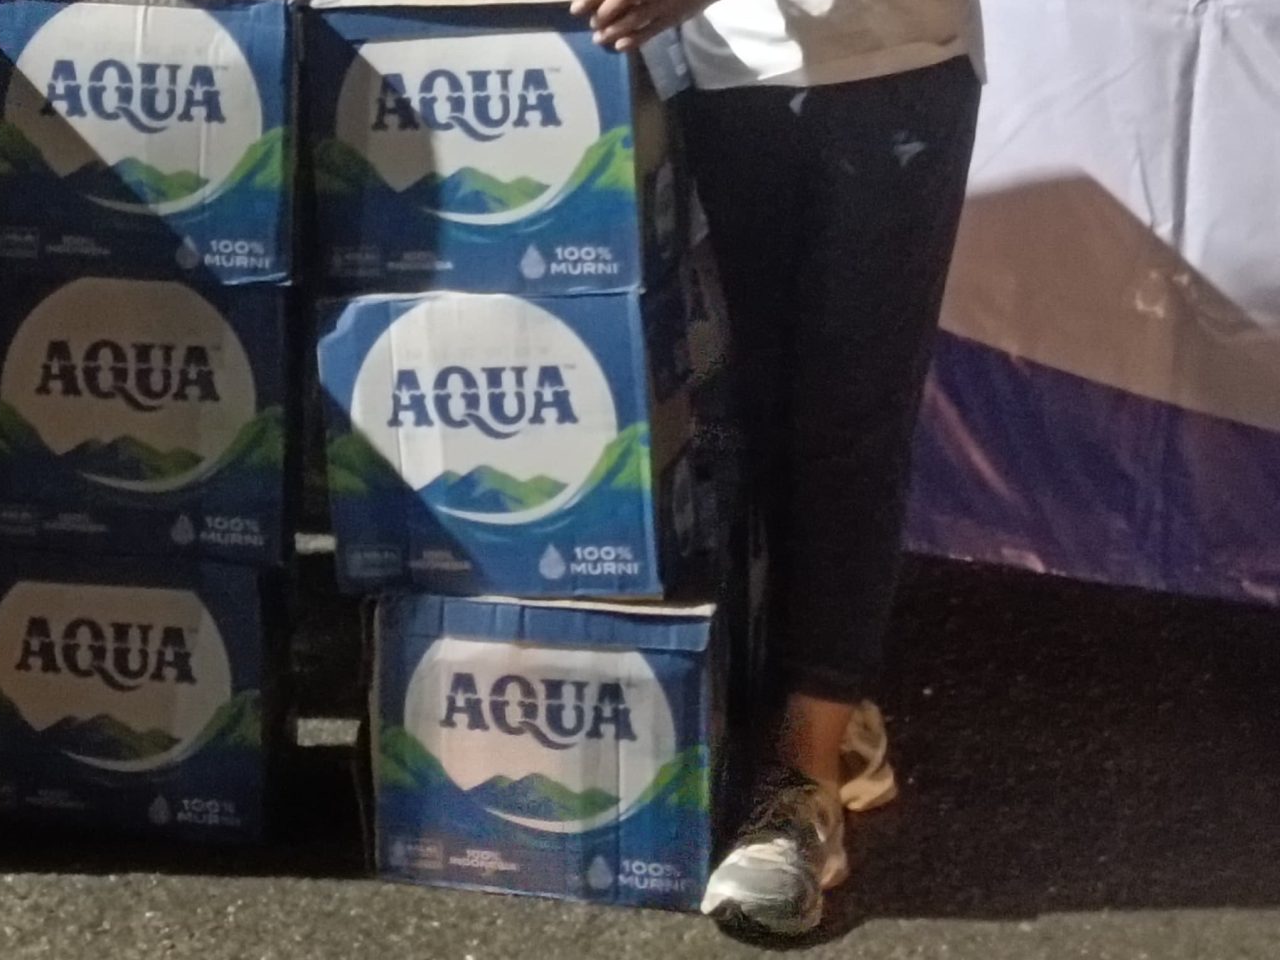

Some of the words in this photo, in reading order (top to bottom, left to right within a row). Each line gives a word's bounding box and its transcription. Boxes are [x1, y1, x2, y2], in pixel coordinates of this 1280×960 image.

[41, 58, 226, 134] AQUA
[371, 68, 562, 142] AQUA
[210, 240, 264, 255] 100%
[555, 246, 613, 261] 100%
[204, 254, 270, 269] MURNI
[551, 262, 618, 276] MURNI
[35, 339, 221, 412] AQUA
[387, 365, 579, 440] AQUA
[574, 546, 633, 561] 100%
[570, 562, 639, 576] MURNI
[15, 616, 198, 691] AQUA
[439, 672, 638, 750] AQUA
[622, 859, 681, 876] 100%
